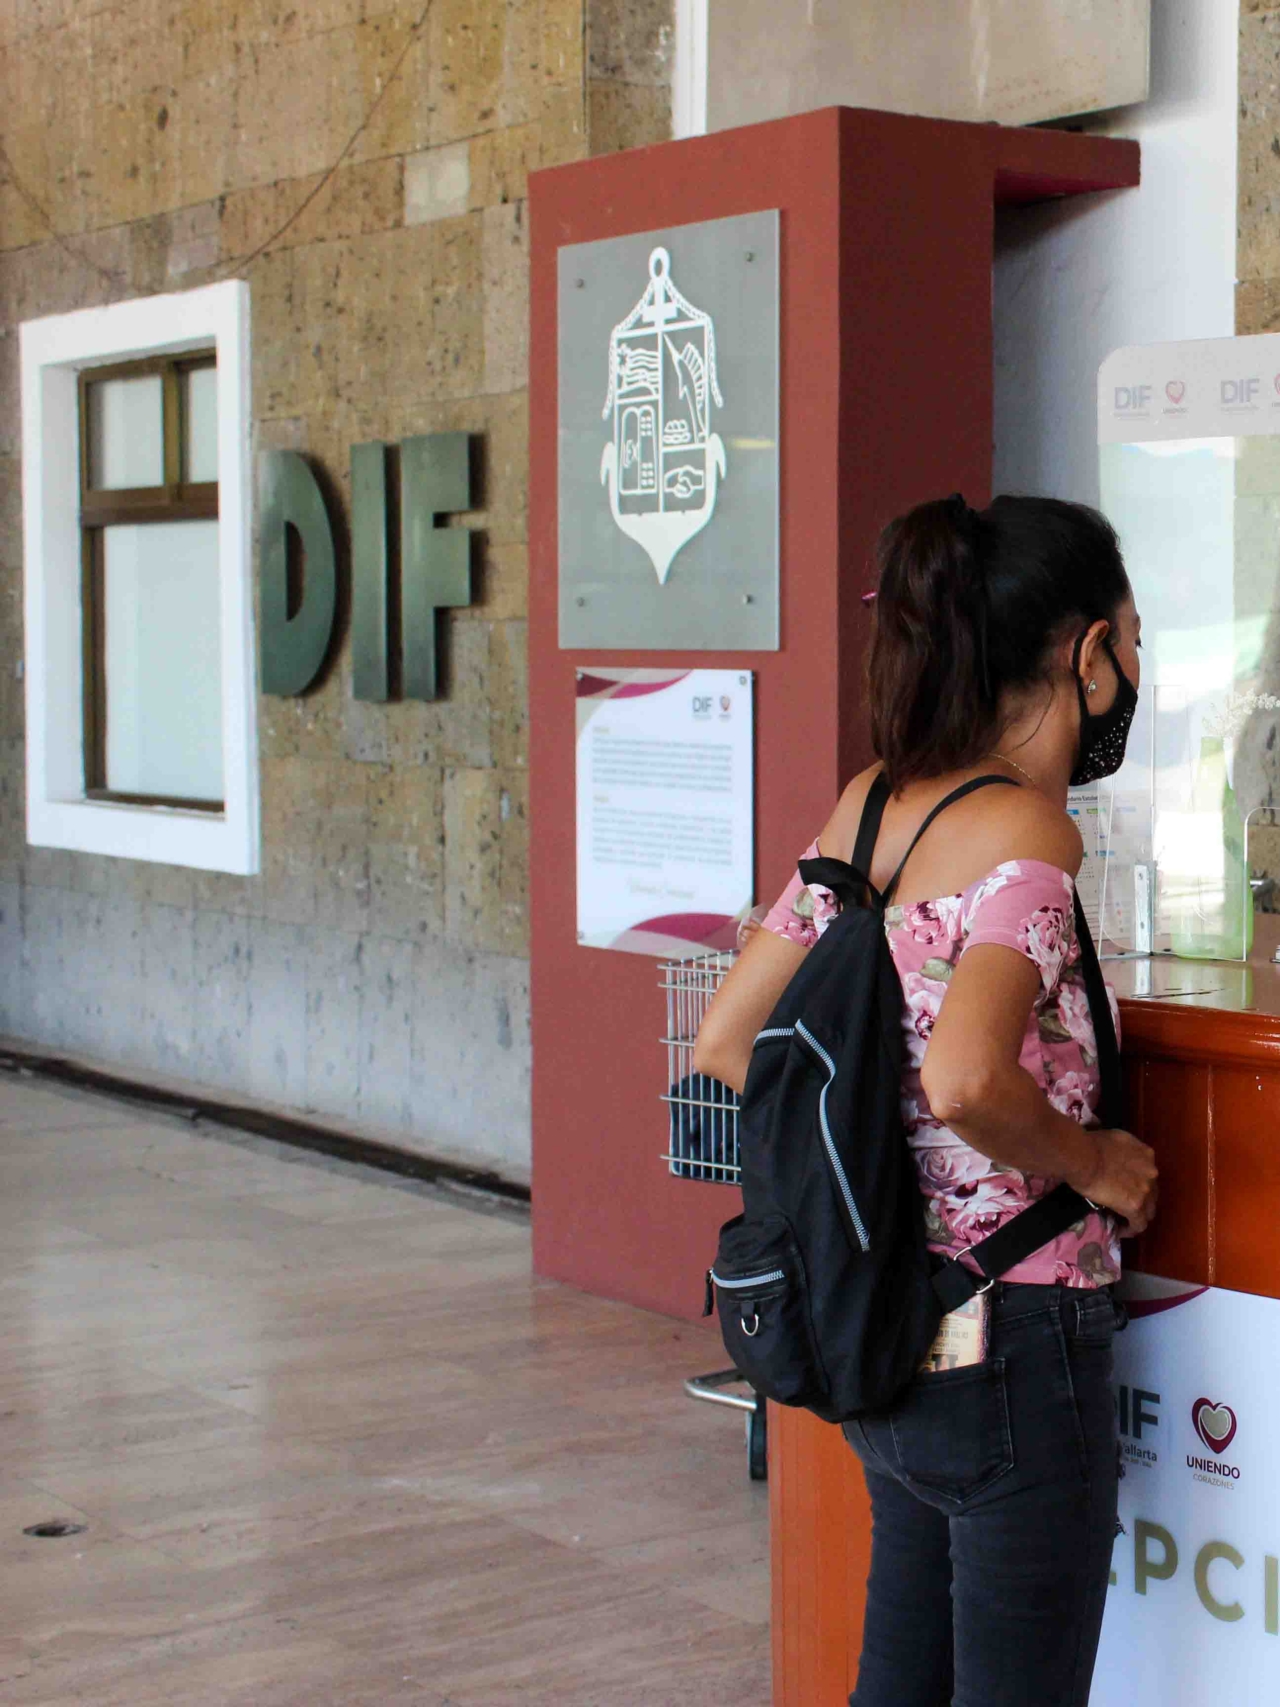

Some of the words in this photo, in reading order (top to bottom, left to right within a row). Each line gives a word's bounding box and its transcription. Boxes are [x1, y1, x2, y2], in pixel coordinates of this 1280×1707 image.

[1114, 385, 1152, 410] DIF
[1220, 378, 1260, 403] DIF
[259, 432, 474, 702] DIF
[692, 696, 713, 712] DIF
[1115, 1385, 1161, 1439] IF
[1186, 1455, 1240, 1479] UNIENDO
[1193, 1473, 1235, 1490] CORAZONES
